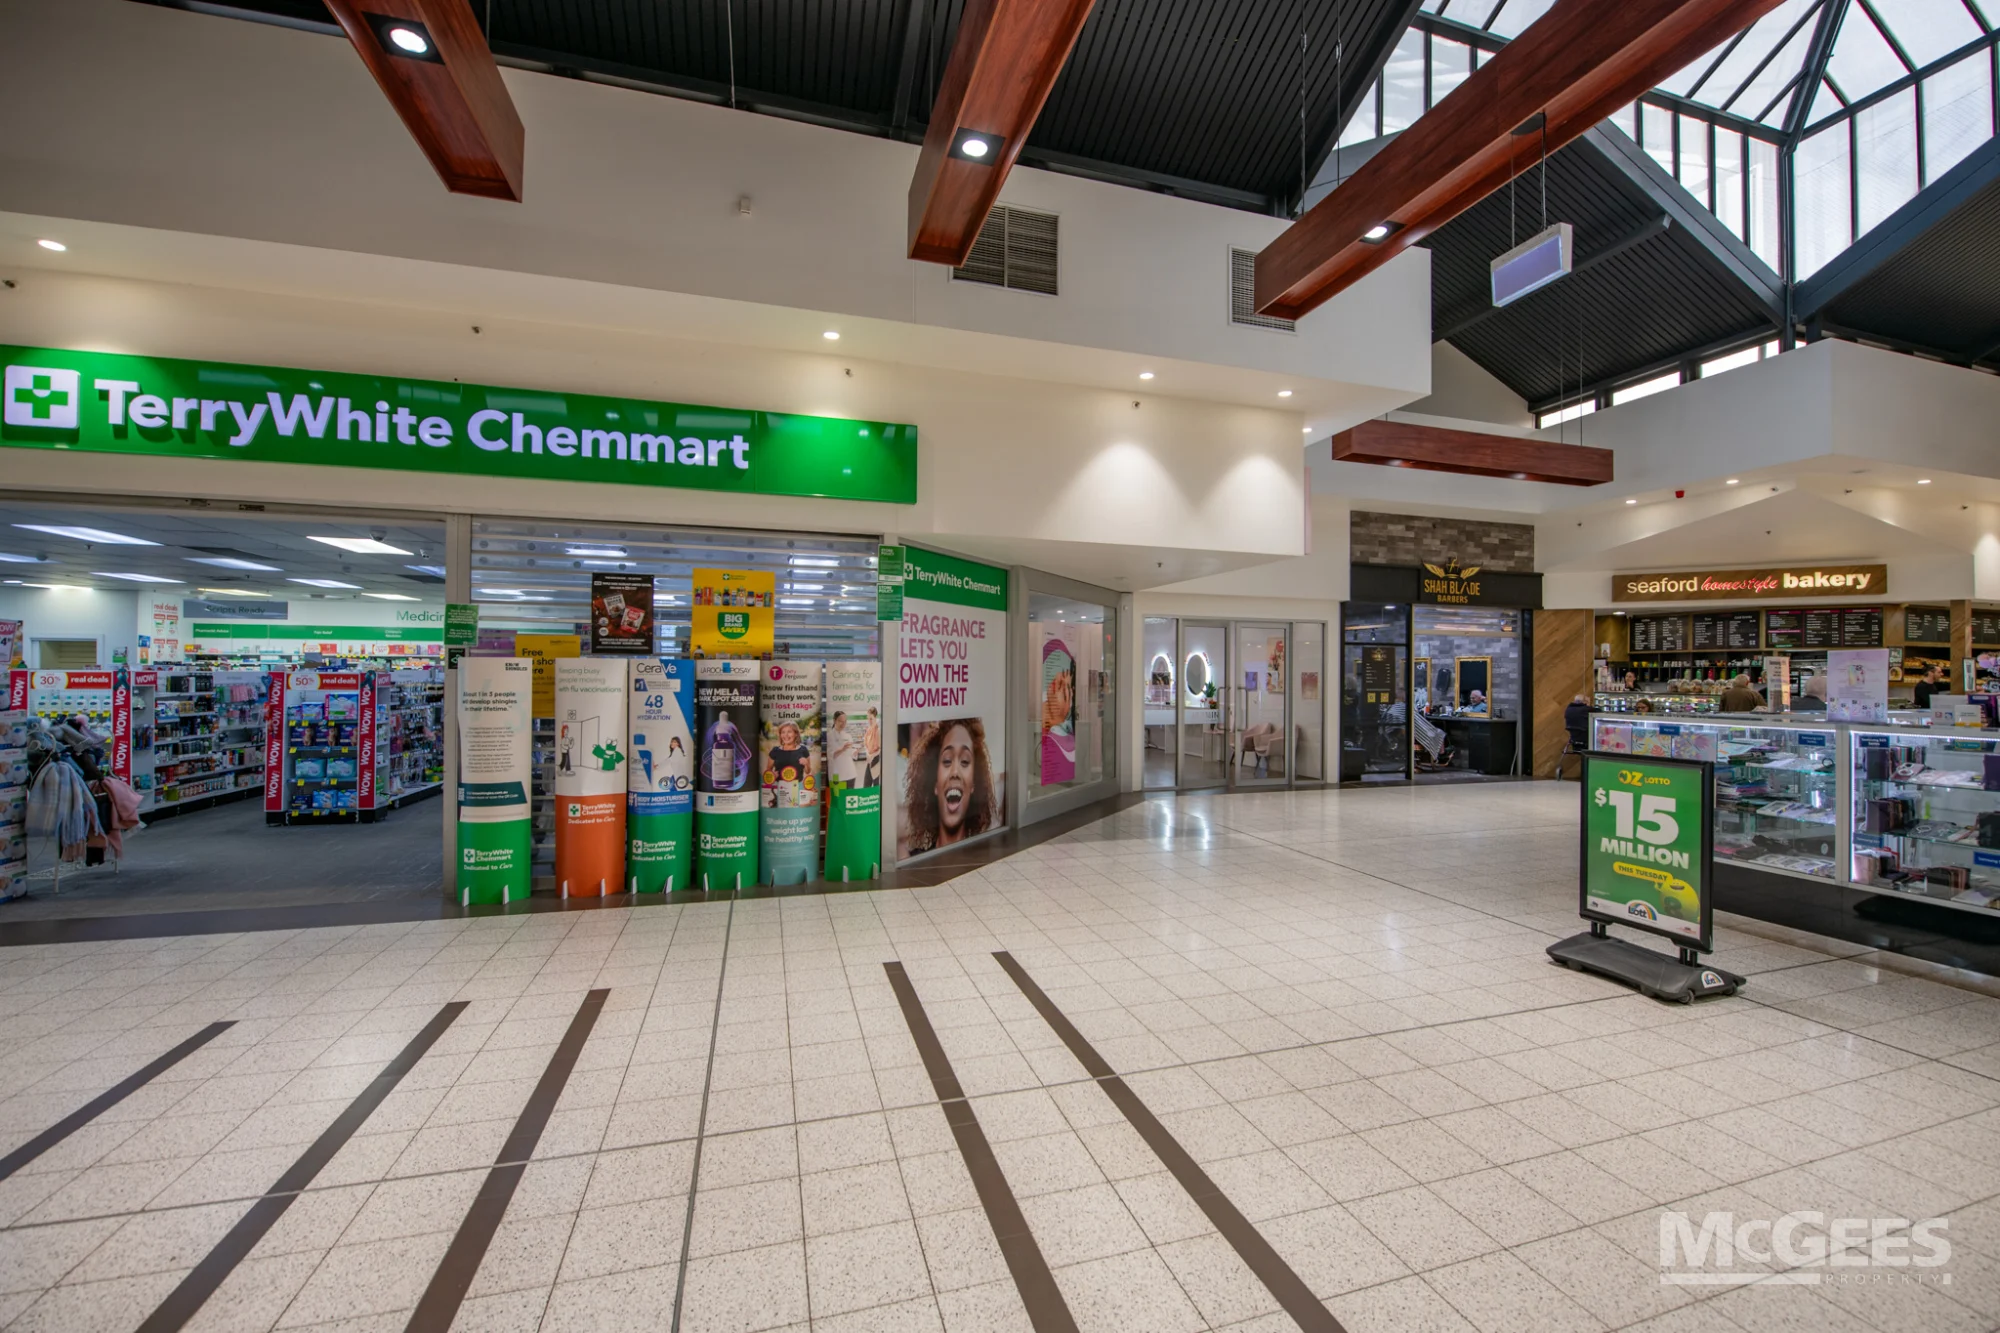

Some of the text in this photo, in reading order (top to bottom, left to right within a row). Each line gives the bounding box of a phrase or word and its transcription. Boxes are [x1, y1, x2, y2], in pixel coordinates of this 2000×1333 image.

[94, 379, 750, 470] TerryWhite Chemmart
[915, 566, 962, 588] TerryWhite
[963, 577, 1000, 595] Chemmart
[1627, 571, 1871, 594] seaford homestyle bakery
[1424, 579, 1480, 596] SHAH BLADE
[1437, 594, 1468, 604] BARBERS
[206, 605, 266, 615] Scripts Ready
[724, 614, 743, 623] BIG
[901, 612, 986, 639] FRAGRANCE
[522, 648, 543, 656] Free
[901, 638, 967, 660] LETS YOU
[584, 667, 600, 675] busy
[636, 662, 677, 674] CeraVe
[832, 669, 874, 680] Caring for
[900, 663, 969, 683] OWN THE
[88, 675, 109, 683] deals
[580, 685, 622, 693] vaccinations
[832, 681, 863, 690] families
[494, 691, 516, 699] people
[699, 688, 739, 696] NEW MELA
[644, 695, 664, 709] 48
[777, 694, 794, 702] they
[832, 693, 865, 702] over 60
[900, 688, 967, 708] MOMENT
[1618, 770, 1671, 787] OZ LOTTO
[582, 803, 616, 812] TerryWhite
[582, 808, 614, 816] Chemmart
[766, 817, 787, 825] Shake
[800, 817, 813, 825] your
[771, 827, 795, 835] weight
[711, 835, 747, 843] TerryWhite
[764, 835, 774, 843] the
[775, 835, 802, 844] healthy
[643, 840, 676, 849] TerryWhite
[476, 848, 514, 857] TerryWhite
[1600, 837, 1689, 870] MILLION
[476, 854, 511, 862] Chemmart
[1618, 864, 1668, 882] THIS TUESDAY
